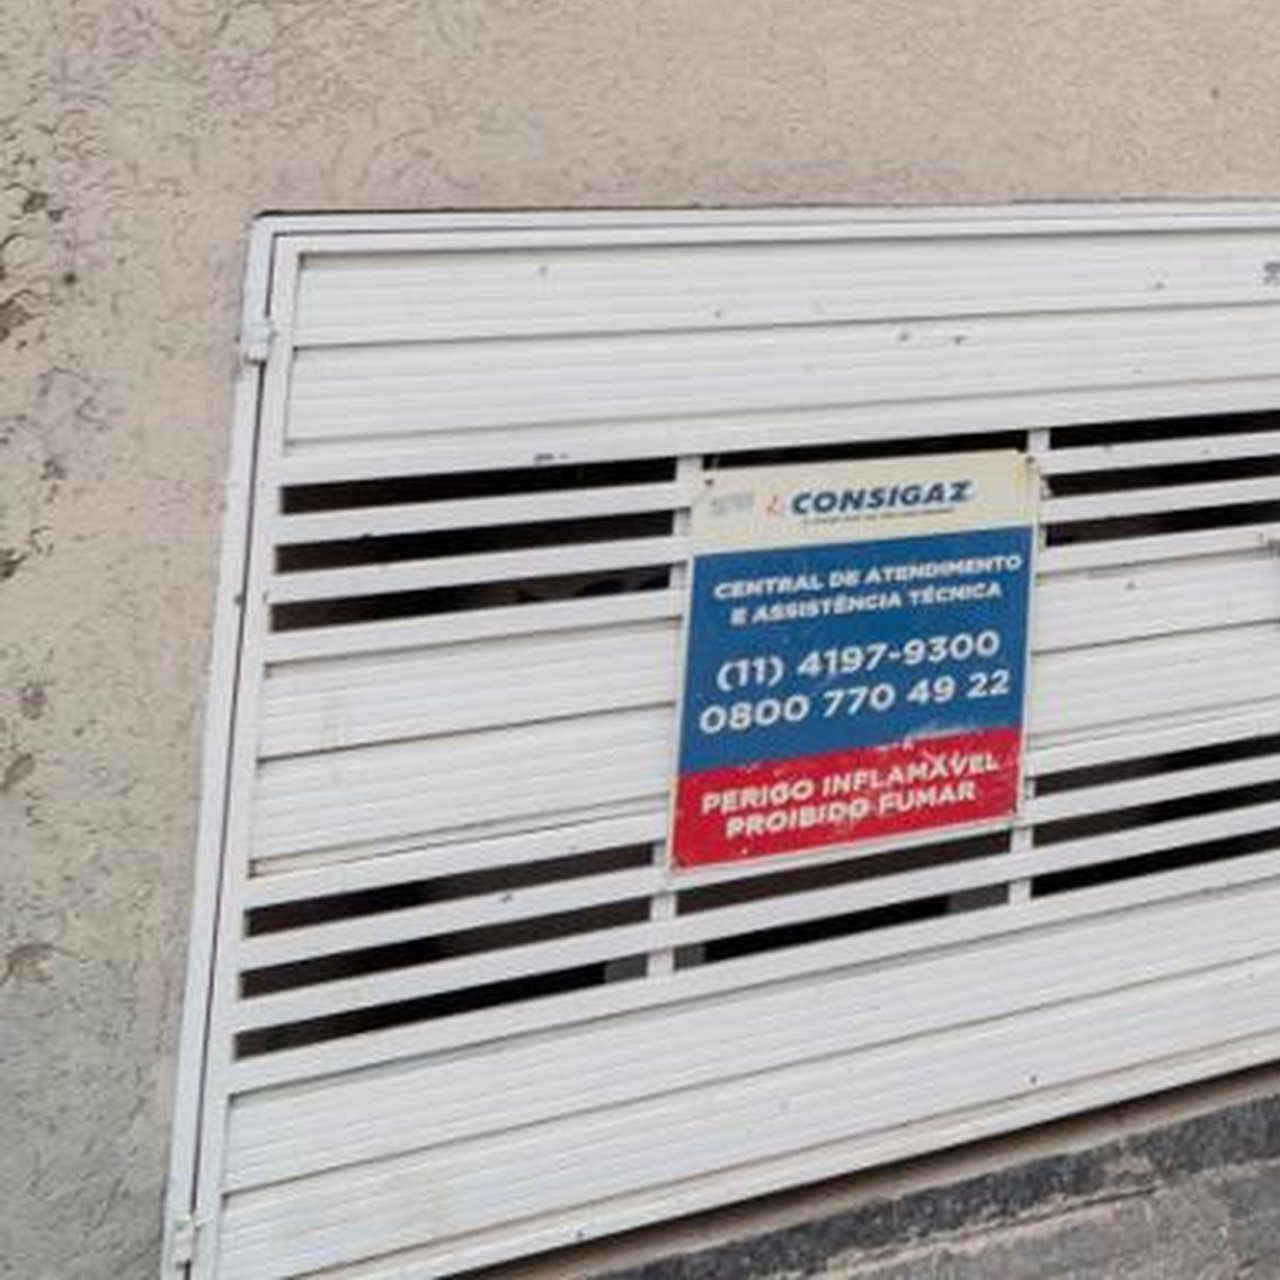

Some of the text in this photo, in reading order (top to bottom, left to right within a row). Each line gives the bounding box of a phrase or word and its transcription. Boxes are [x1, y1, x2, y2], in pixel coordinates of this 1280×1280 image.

[791, 480, 972, 516] CONSIGAZ
[714, 553, 1023, 600] CENTRAL DE ATENDIMENTO
[731, 579, 1001, 627] E ASSISTÊNCIA TÉCNICA
[716, 629, 1001, 692] (11) 4197-9300
[700, 668, 1010, 734] 0800 770 49 22
[702, 750, 1000, 816] PERIGO INFLAMÁVEL
[725, 778, 977, 840] PROIBIDO FUMAR
